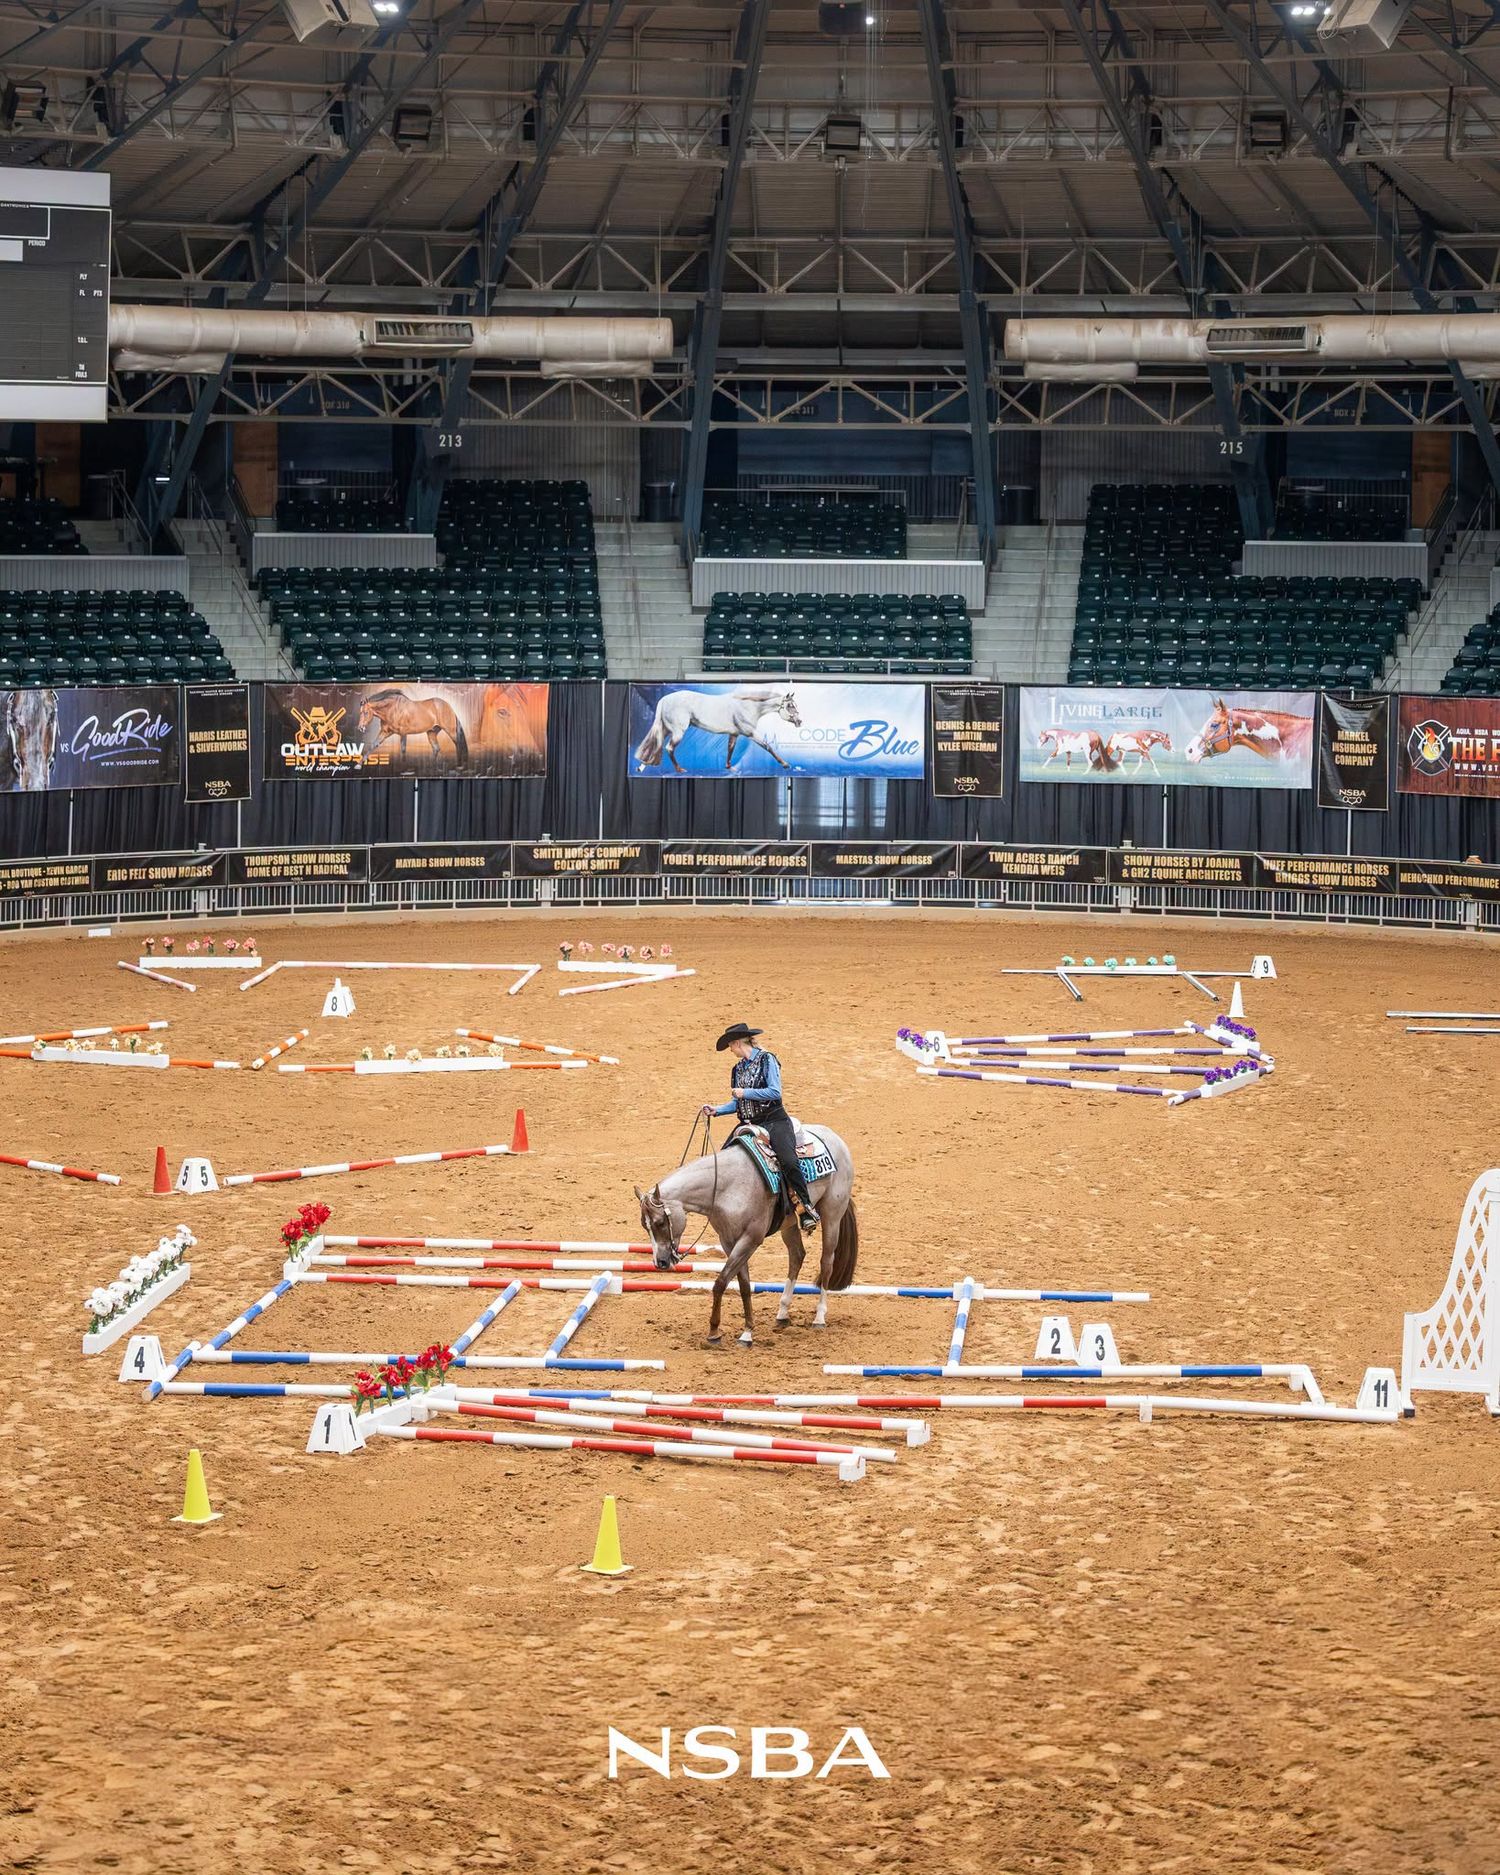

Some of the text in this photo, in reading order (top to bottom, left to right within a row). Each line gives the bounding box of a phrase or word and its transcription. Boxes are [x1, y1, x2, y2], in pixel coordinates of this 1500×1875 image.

[1334, 409, 1348, 417] BOX
[439, 434, 462, 448] 213
[1220, 442, 1243, 454] 215
[936, 721, 1000, 732] DENNIS & DEBBIE
[189, 730, 247, 742] HARRIS LEATHER
[799, 720, 920, 762] CODE Blue
[953, 732, 982, 741] MARTIN
[1338, 731, 1370, 742] MARKEL
[190, 741, 248, 754] & SILVERWORKS
[280, 743, 364, 757] OUTLAW
[938, 742, 997, 752] KYLEE WISEMAN
[1332, 743, 1377, 754] INSURANCE
[1448, 737, 1486, 761] THE
[1334, 755, 1374, 766] COMPANY
[954, 777, 980, 785] NSBA
[1338, 788, 1366, 796] NSBA
[244, 853, 350, 867] THOMPSON SHOW HORSES
[533, 847, 641, 859] SMITH HORSE COMPANY
[836, 855, 932, 865] MAESTAS SHOW HORSES
[989, 852, 1079, 865] TWIN ACRES RANCH
[396, 856, 485, 869] MAYABB SHOW HORSES
[554, 859, 620, 870] COLTON SMITH
[663, 854, 807, 867] YODER PERFORMANCE HORSES
[1123, 855, 1240, 869] SHOW HORSES BY JOANNA
[1263, 859, 1389, 876] HUFF PERFORMANCE HORSES
[11, 867, 42, 878] BOUTIQUE
[46, 865, 65, 875] KEVIN
[66, 864, 88, 874] GARCIA
[107, 865, 213, 881] ERIC FELT SHOW HORSES
[247, 864, 348, 878] HOME OF BEST N RADICAL
[1002, 863, 1065, 876] KENDRA WEIS
[1122, 868, 1242, 881] & GH2 EQUINE ARCHITECTS
[34, 877, 59, 888] CUSTOM
[60, 876, 89, 886] CLOTHING
[1275, 873, 1377, 888] BRIGGS SHOW HORSES
[1445, 875, 1500, 889] PERFORMANCE
[1263, 960, 1269, 974] 9
[331, 996, 338, 1012] 8
[934, 1036, 940, 1052] 6
[815, 1156, 832, 1174] 819
[182, 1165, 189, 1186] 5
[200, 1166, 208, 1186] 5
[1051, 1328, 1061, 1354] 2
[1095, 1335, 1105, 1361] 3
[134, 1346, 145, 1373] 4
[1374, 1379, 1388, 1407] 11
[324, 1414, 331, 1444] 1
